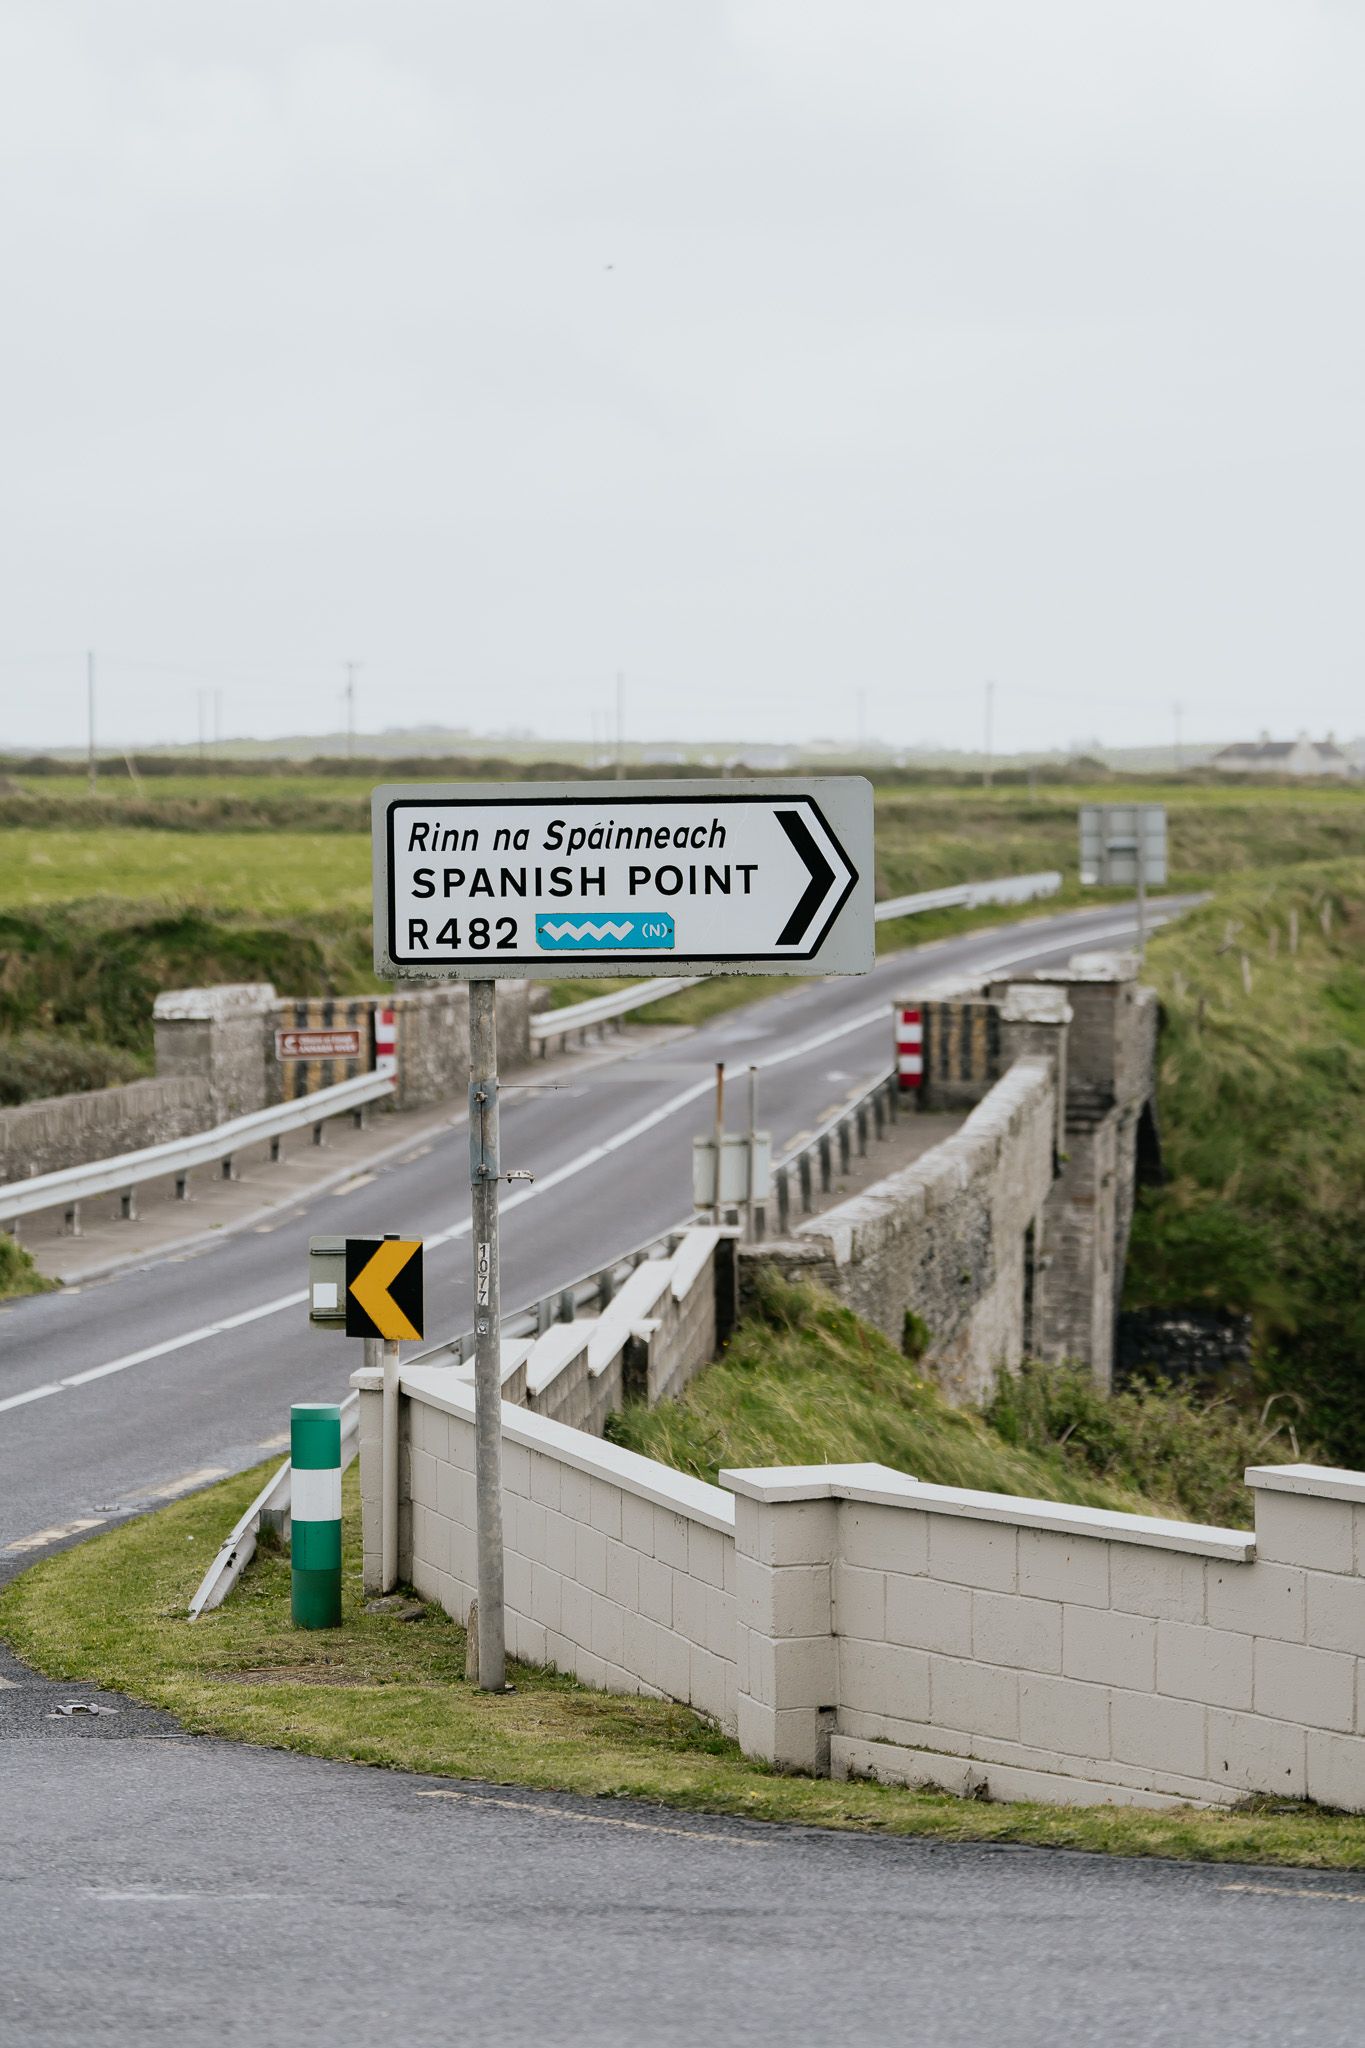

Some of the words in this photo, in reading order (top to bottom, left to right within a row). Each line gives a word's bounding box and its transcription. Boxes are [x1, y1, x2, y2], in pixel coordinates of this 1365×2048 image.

[407, 822, 479, 852] Rinn
[492, 828, 530, 851] na
[542, 818, 727, 857] Spáinneach
[411, 865, 606, 899] SPANISH
[628, 864, 759, 896] POINT
[408, 916, 518, 950] R482
[641, 922, 668, 938] (N)
[478, 1244, 488, 1302] 1077
